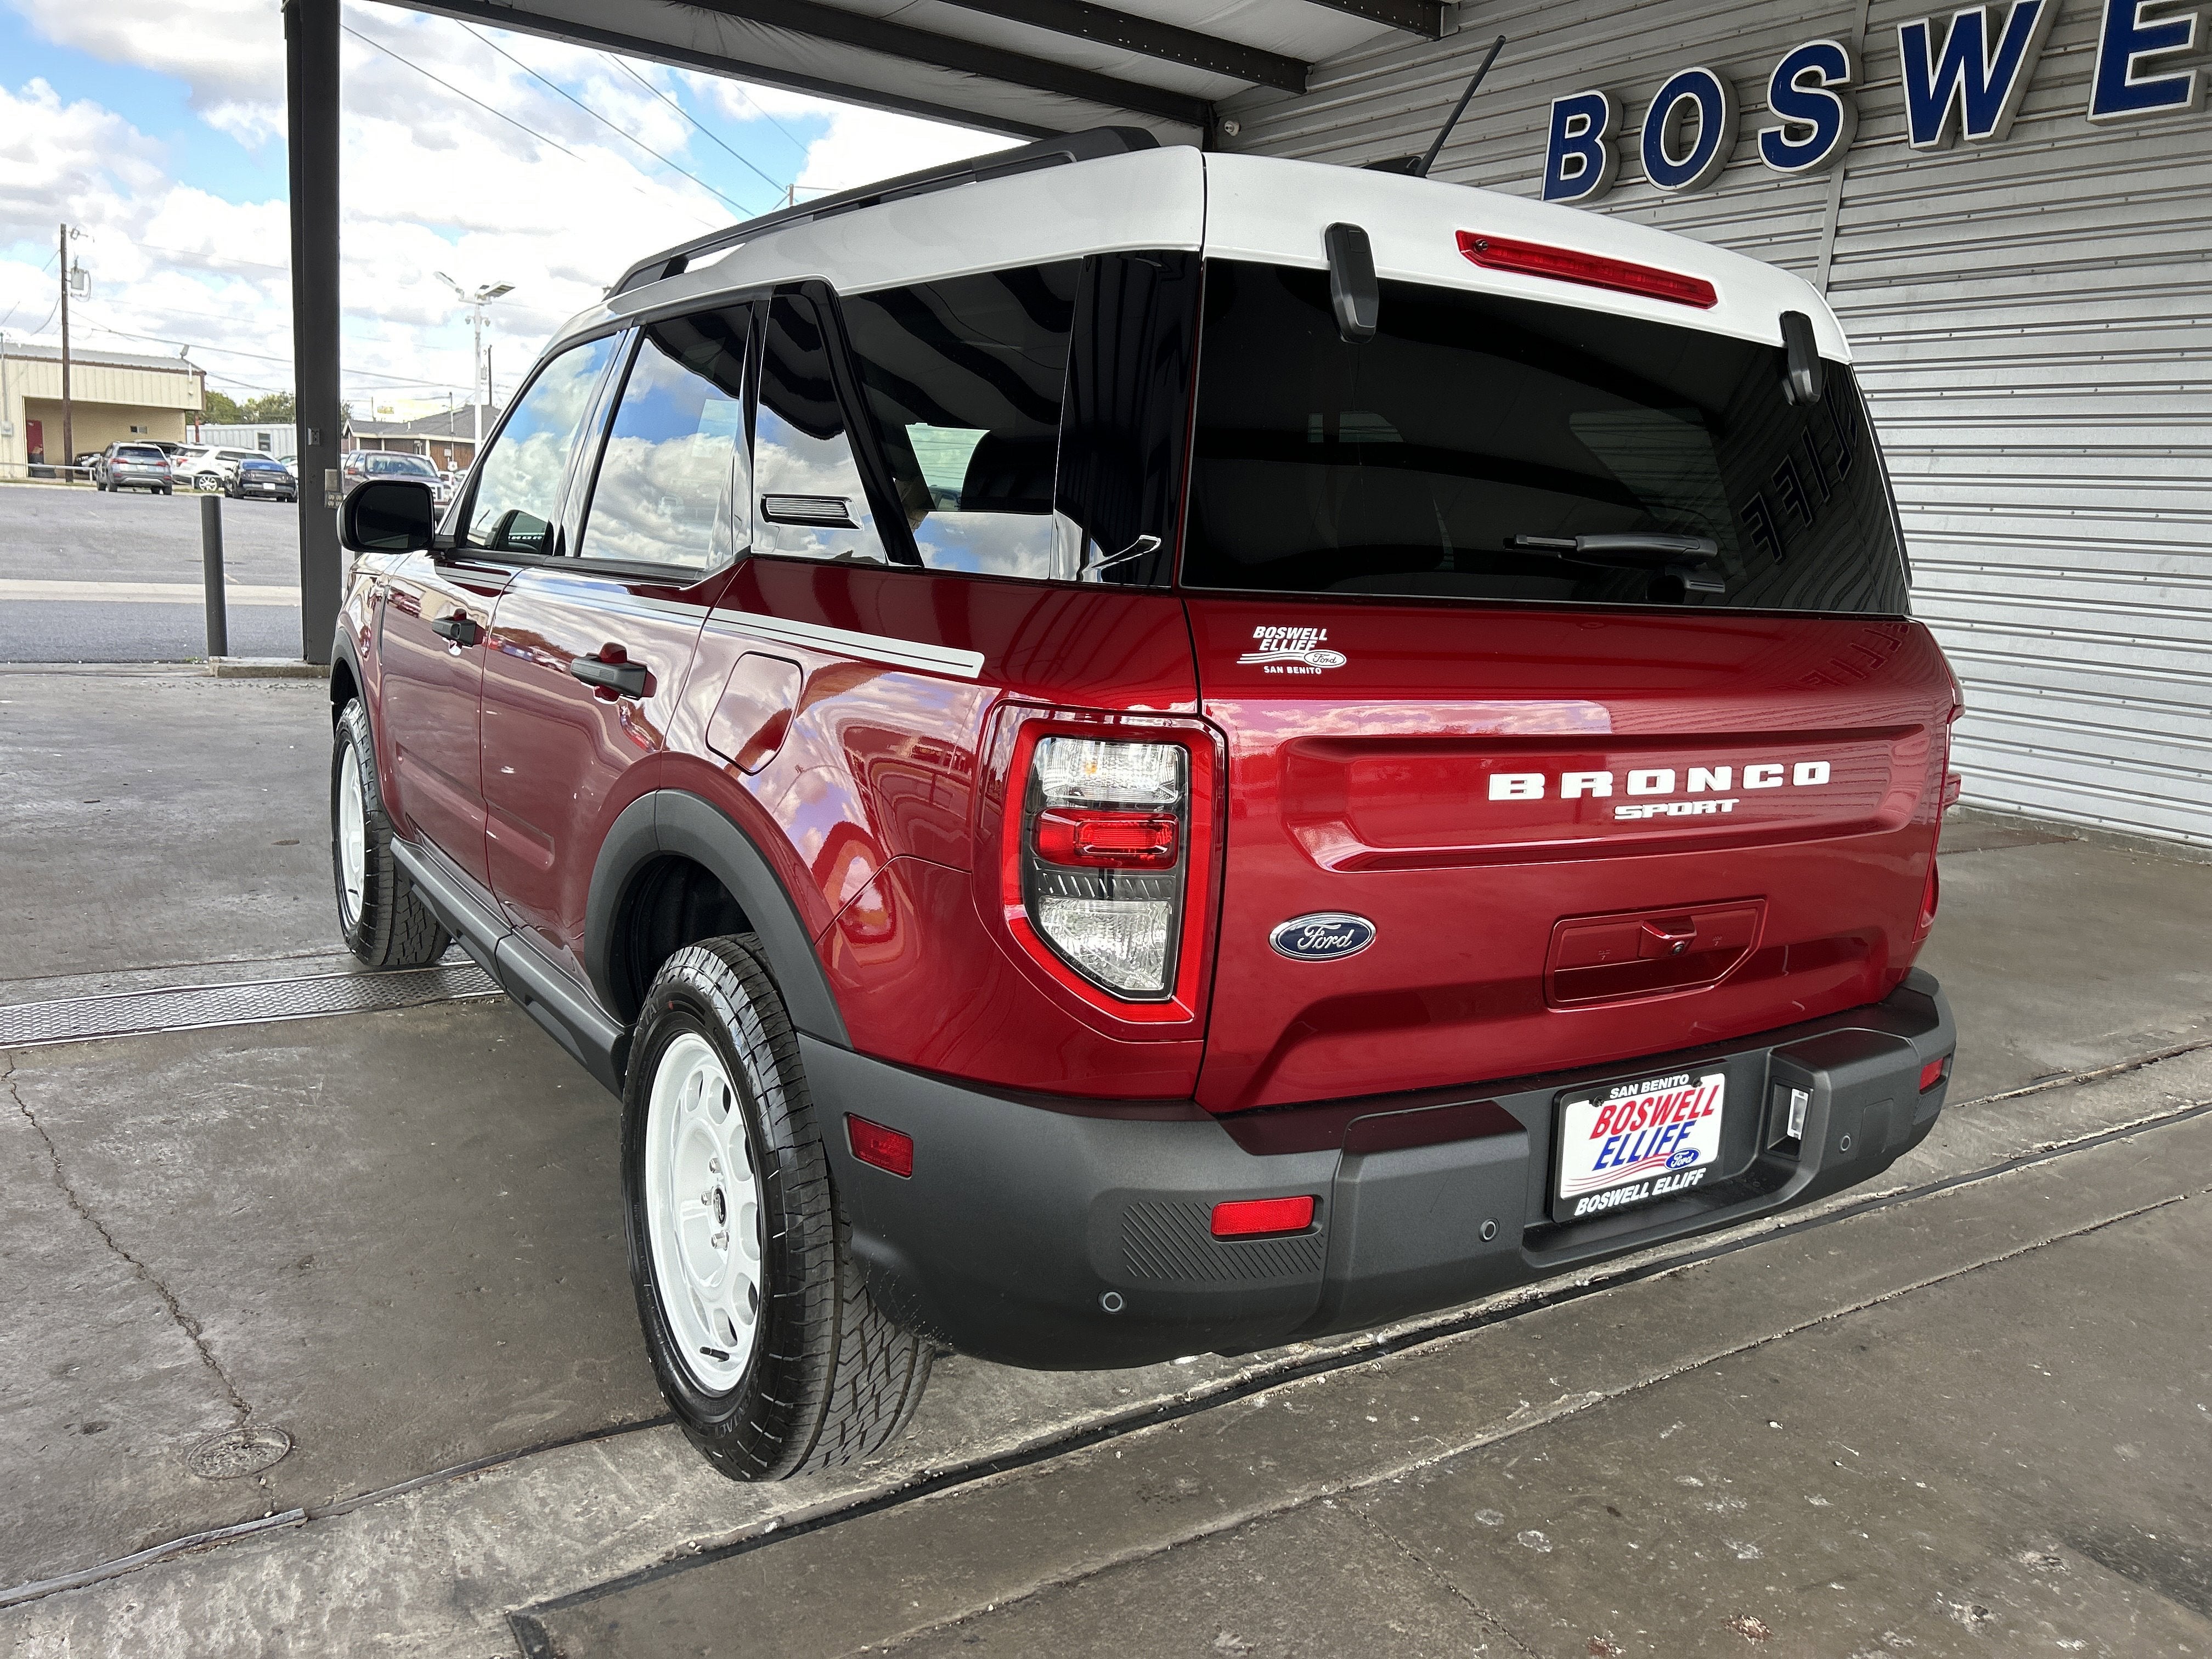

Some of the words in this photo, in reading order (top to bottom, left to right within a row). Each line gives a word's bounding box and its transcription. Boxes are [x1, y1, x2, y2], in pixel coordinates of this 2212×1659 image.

[1542, 0, 2199, 201] BOSWE
[1252, 626, 1328, 641] BOSWELL
[1259, 639, 1317, 651] ELLIFF
[1263, 665, 1284, 674] SAN
[1286, 666, 1322, 675] BENITO
[1312, 653, 1337, 664] Ford
[1488, 761, 1831, 801] BRONCO
[1614, 798, 1740, 820] SPORT
[1297, 923, 1355, 950] Ford
[1609, 1083, 1639, 1099] SAN
[1640, 1073, 1690, 1094] BENITO
[1589, 1084, 1720, 1140] BOSWELL
[1592, 1119, 1697, 1171] ELLIFF
[1671, 1150, 1694, 1169] Ford
[1574, 1182, 1650, 1216] BOSWELL
[1652, 1167, 1707, 1196] ELLIFF
